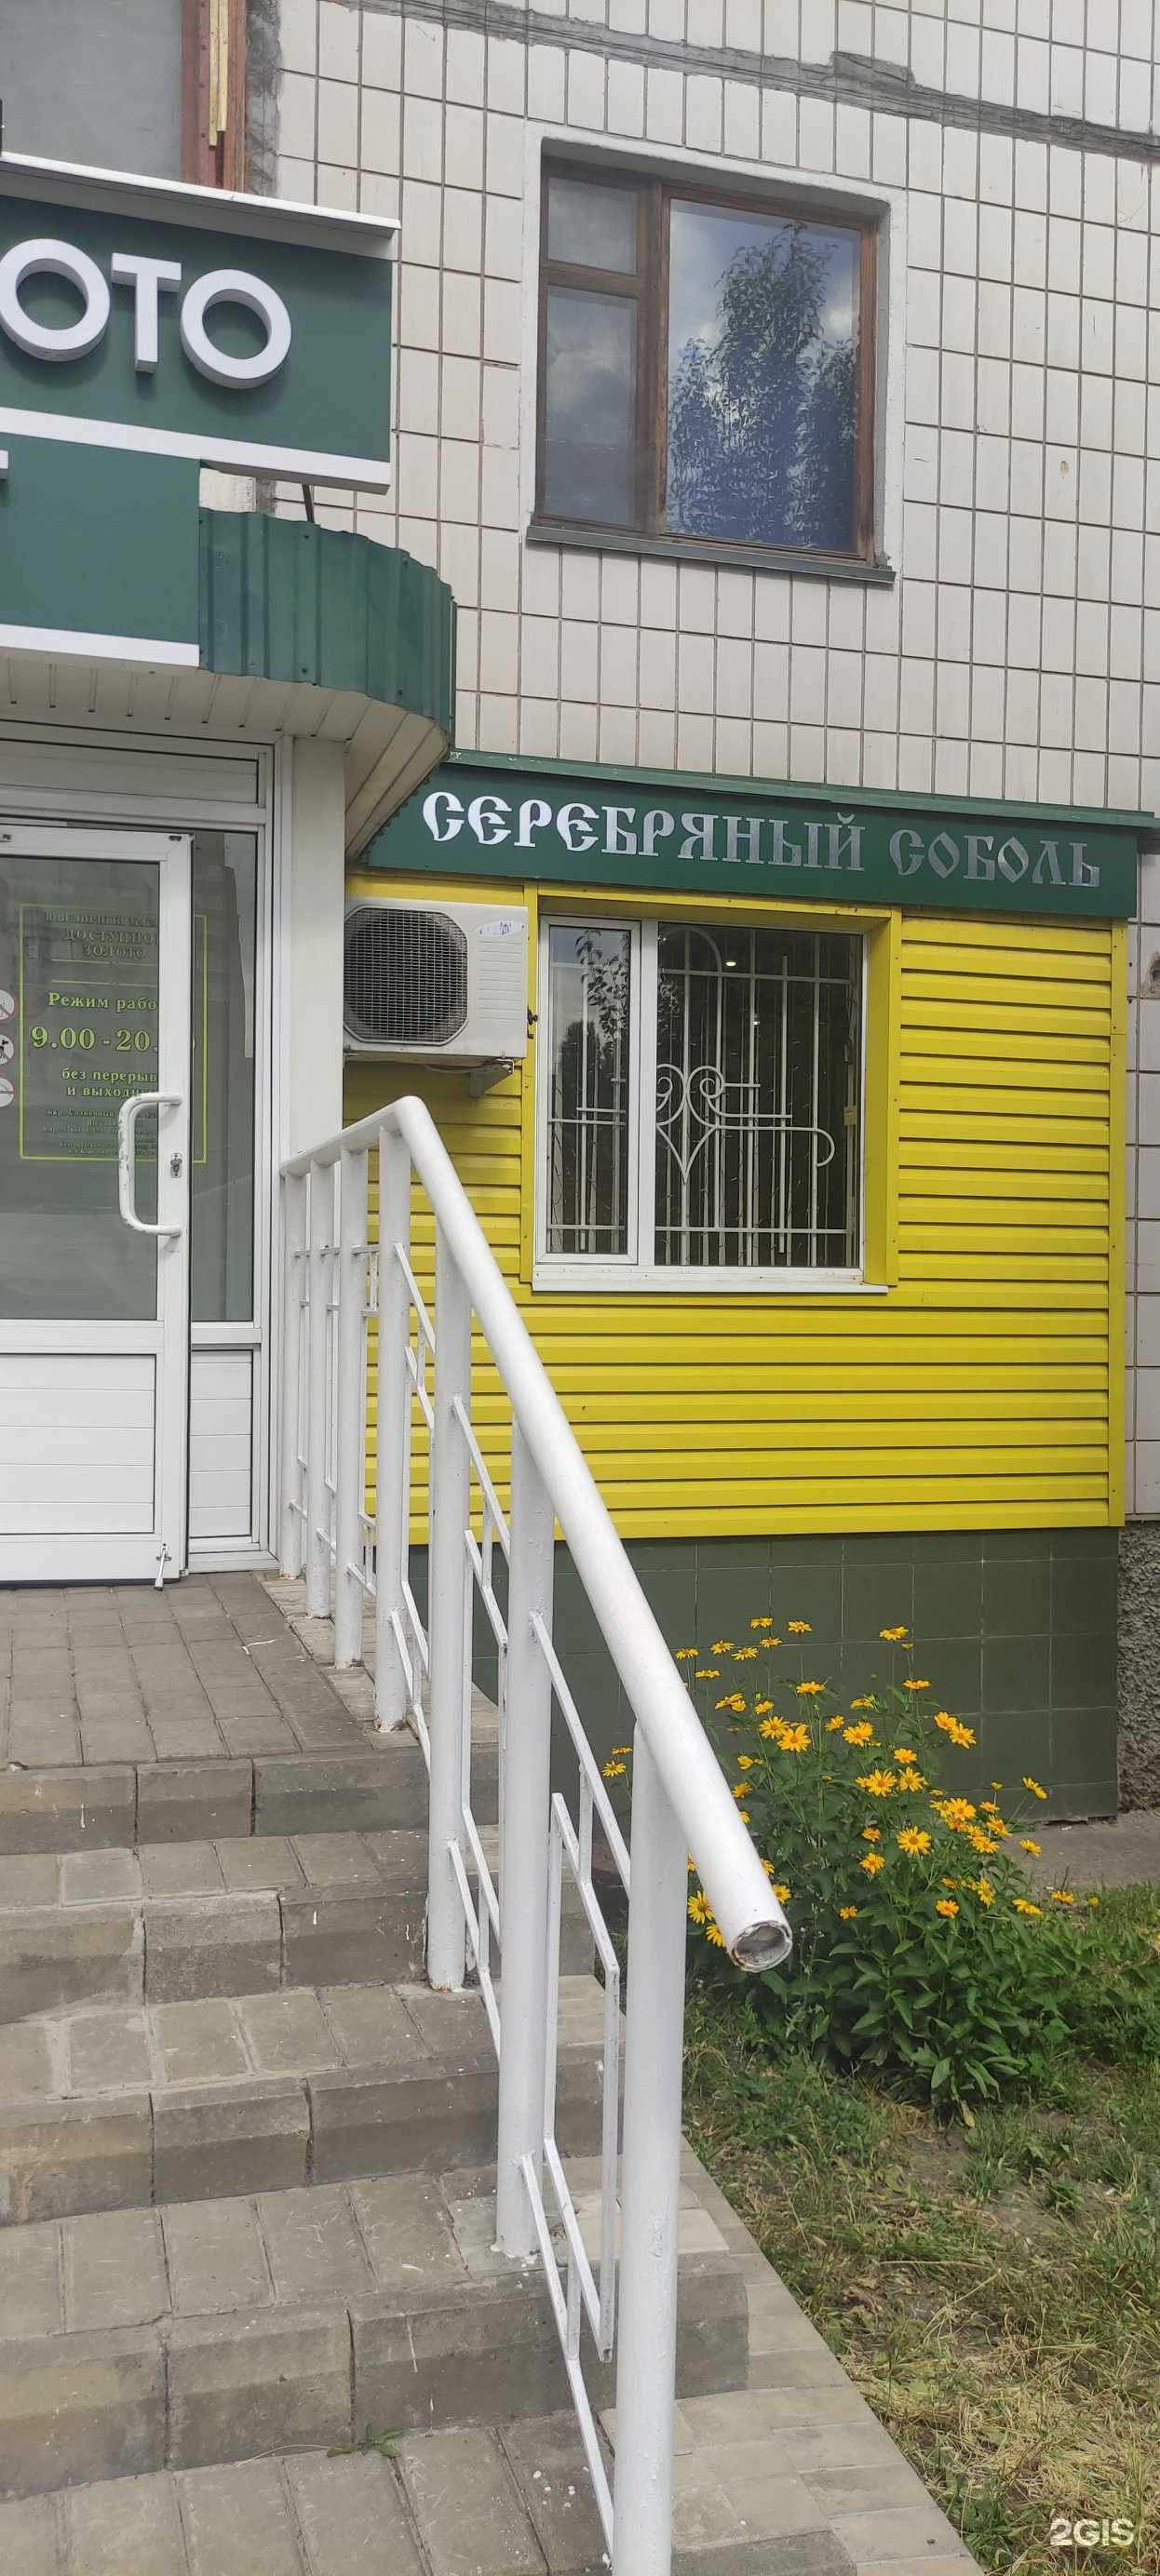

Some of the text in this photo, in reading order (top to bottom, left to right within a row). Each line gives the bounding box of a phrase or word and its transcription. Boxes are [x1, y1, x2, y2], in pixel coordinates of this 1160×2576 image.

[423, 791, 1100, 888] СЕРЕБРЯНЫЙ СОБОЛЬ
[63, 928, 158, 946] ДОСТУПНО
[48, 992, 157, 1013] Режим рабо
[61, 1068, 157, 1084] без перерыв
[67, 1087, 147, 1098] и выходн
